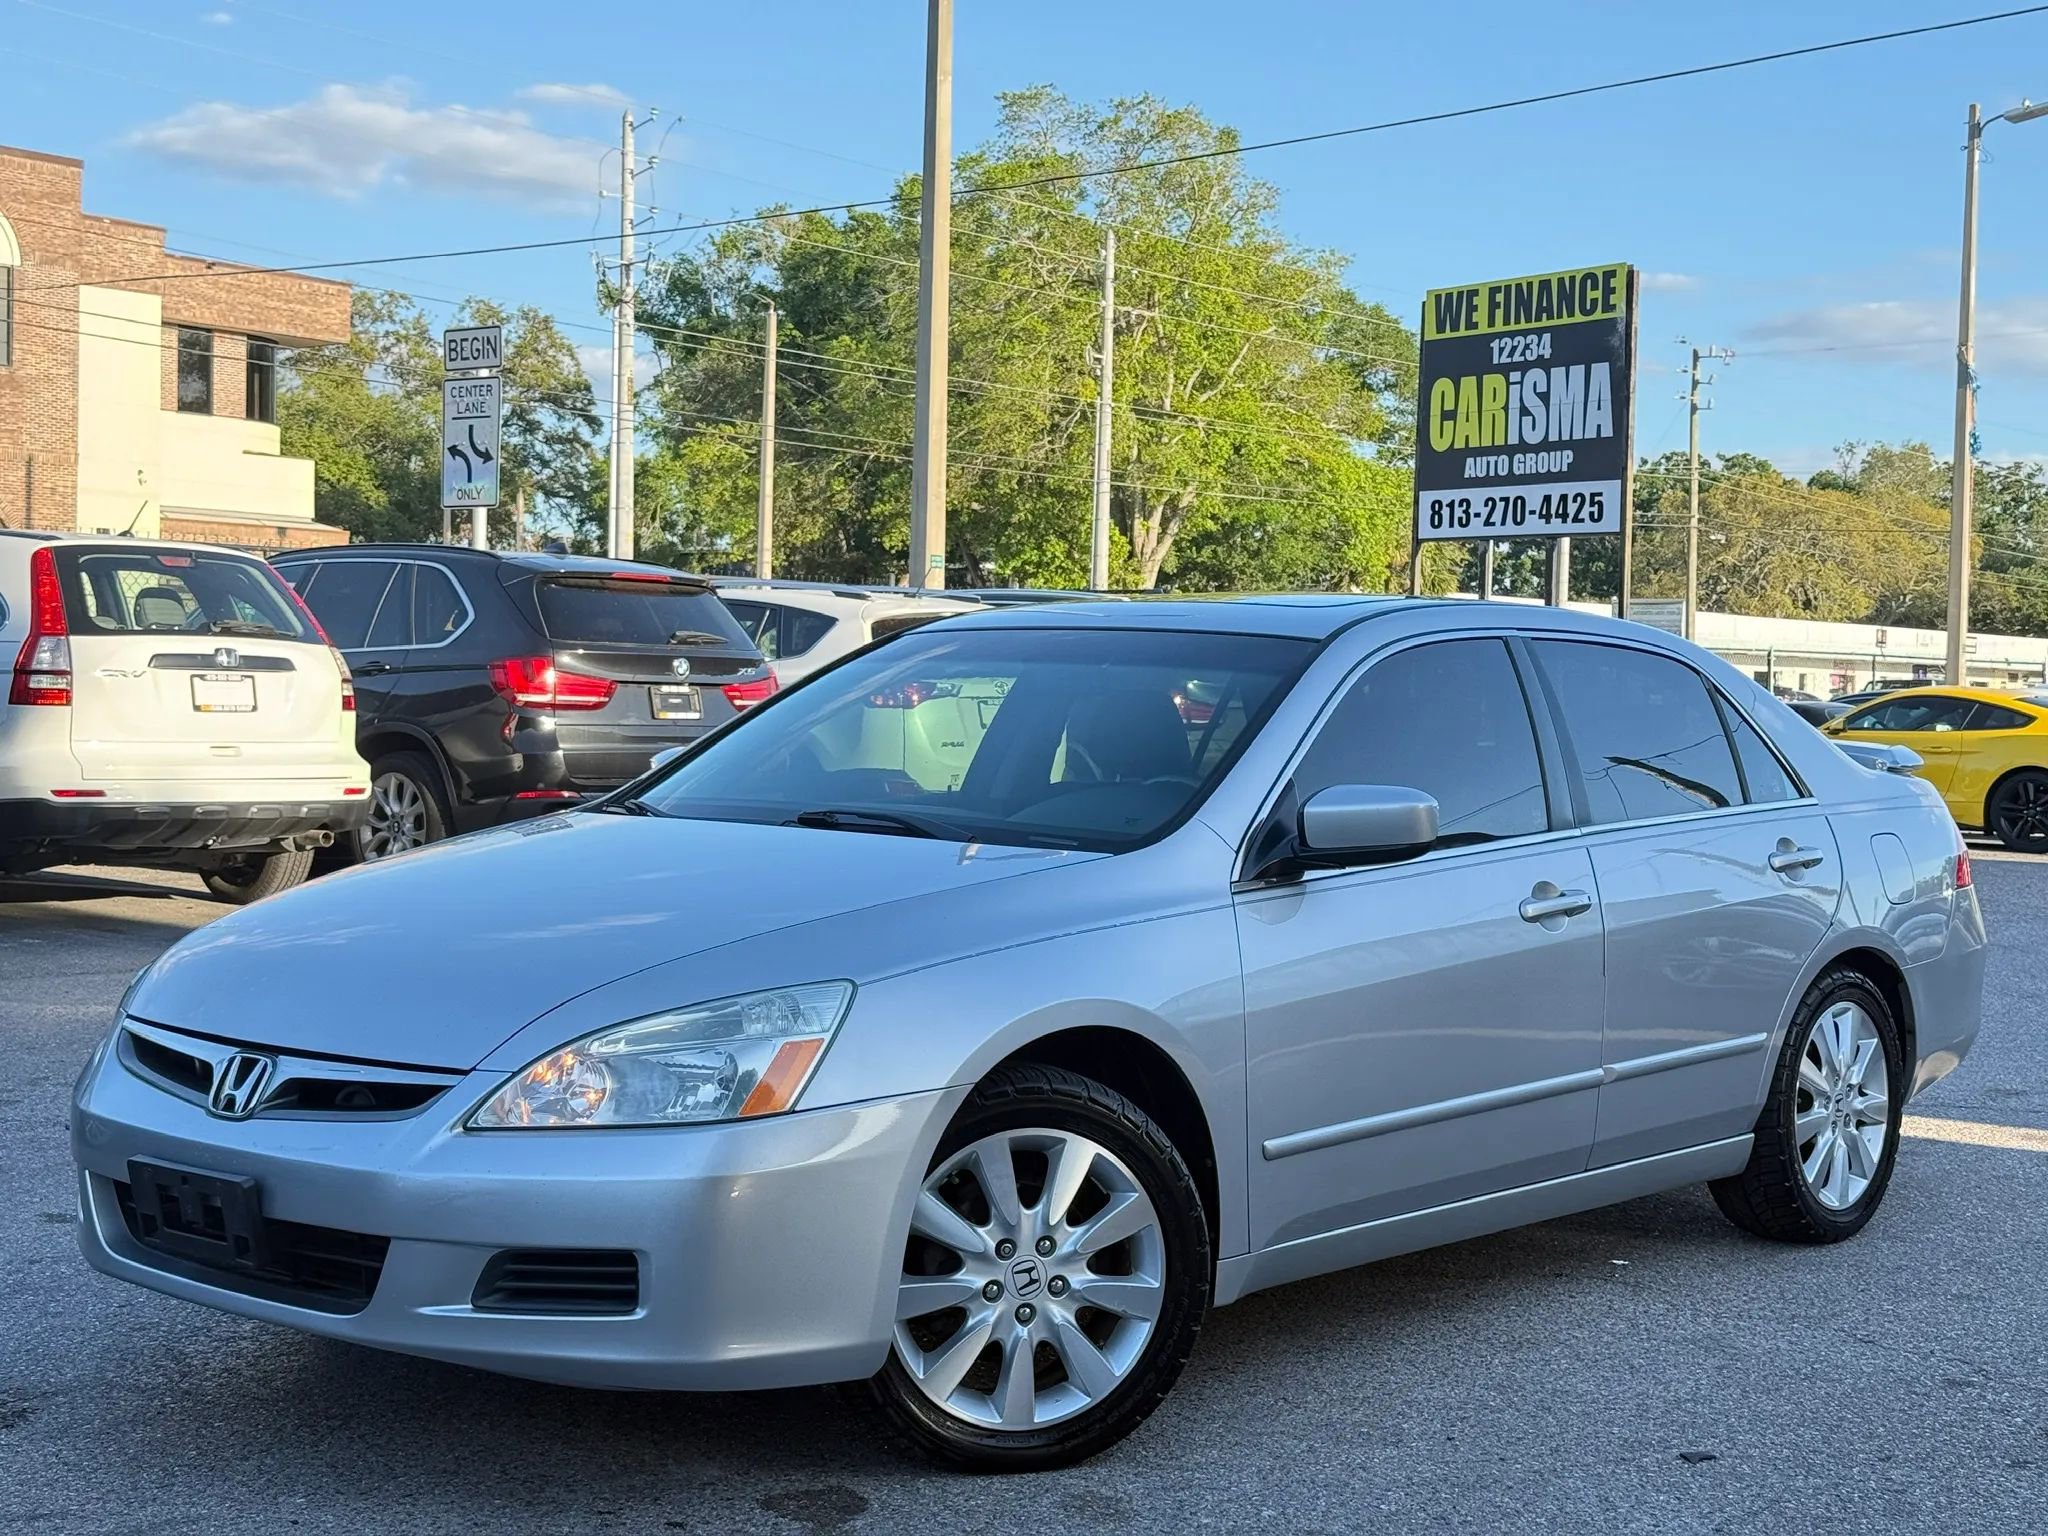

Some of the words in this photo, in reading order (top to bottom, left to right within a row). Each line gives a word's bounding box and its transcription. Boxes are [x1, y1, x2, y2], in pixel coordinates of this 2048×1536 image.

[1434, 289, 1479, 334] WE
[1488, 269, 1617, 328] FINANCE
[448, 335, 498, 362] BEGIN
[1490, 333, 1552, 364] 12234
[450, 384, 493, 399] CENTER
[457, 402, 487, 415] LANE
[1464, 454, 1509, 478] AUTO
[1513, 450, 1574, 475] GROUP
[456, 488, 483, 500] ONLY
[1430, 492, 1604, 529] 813-270-4425
